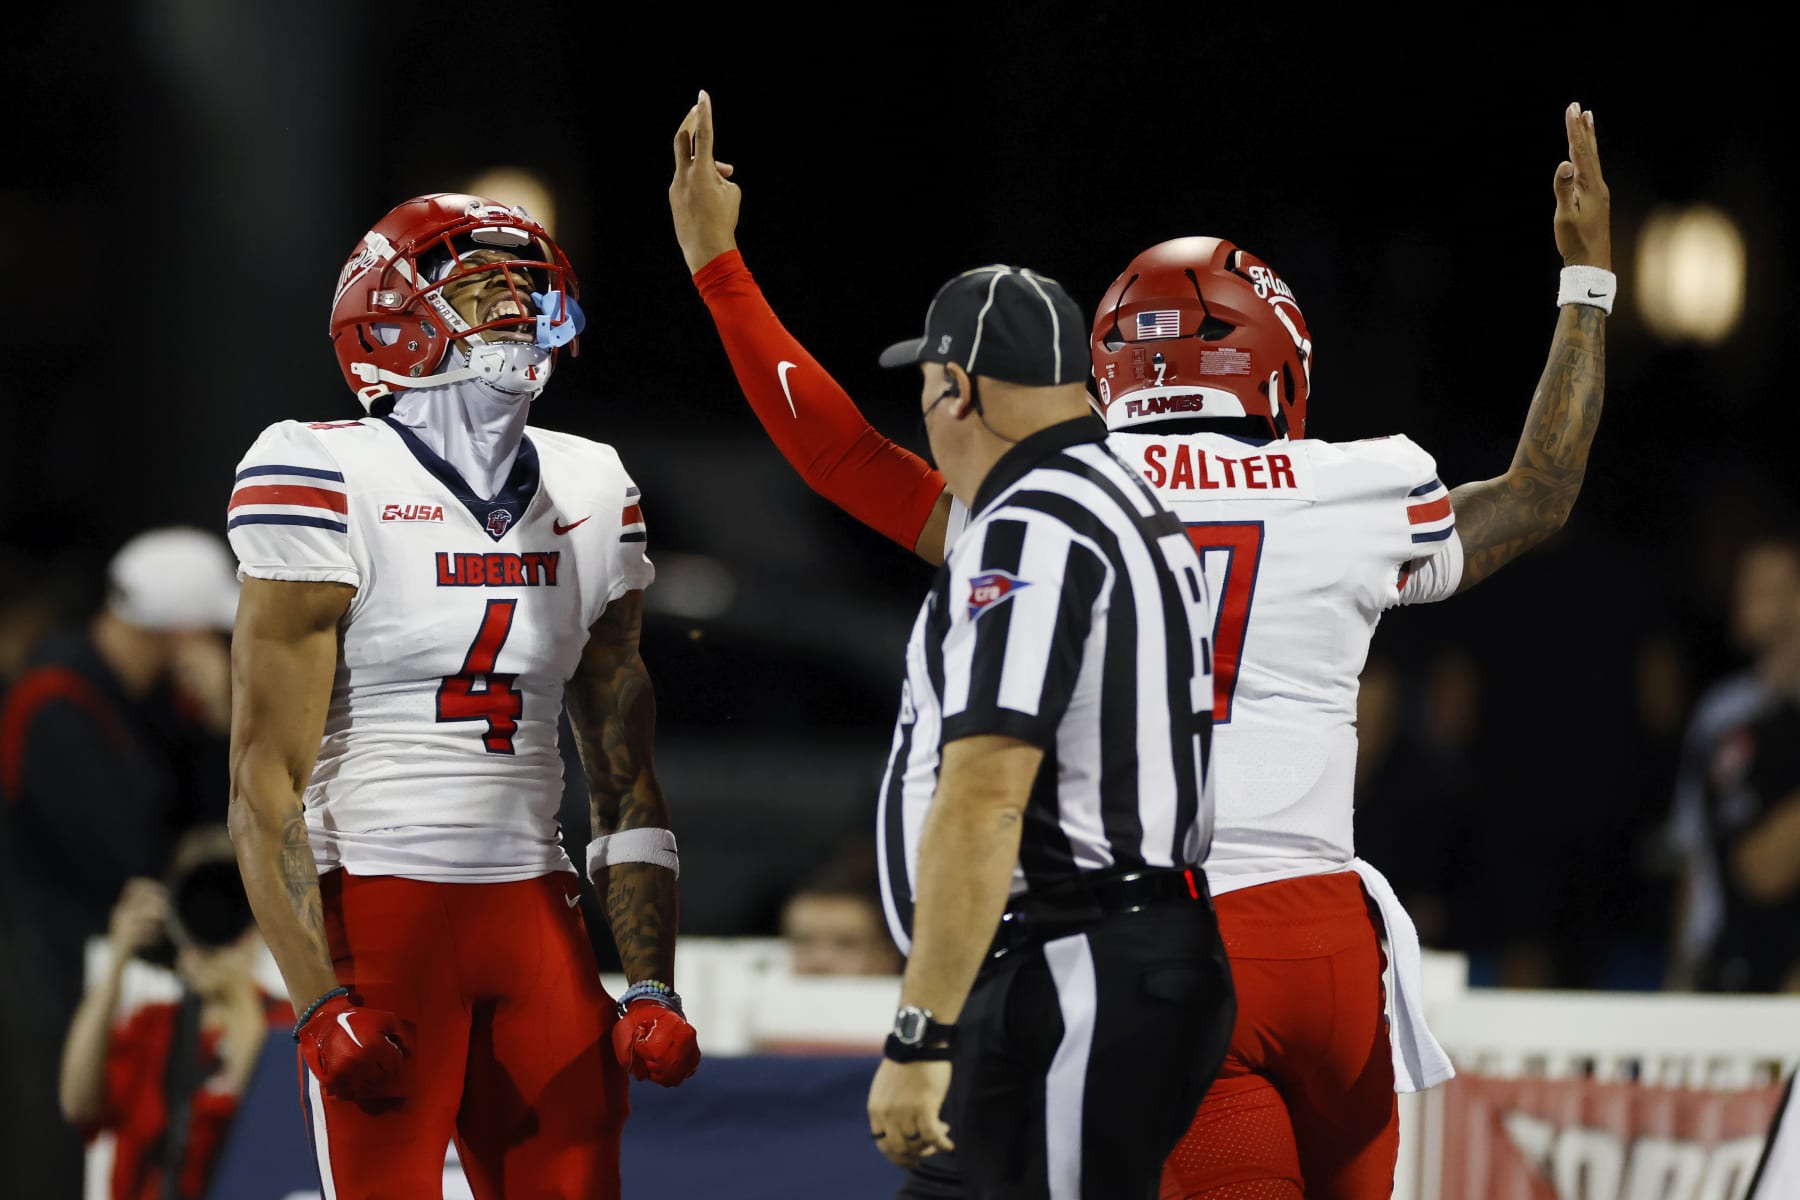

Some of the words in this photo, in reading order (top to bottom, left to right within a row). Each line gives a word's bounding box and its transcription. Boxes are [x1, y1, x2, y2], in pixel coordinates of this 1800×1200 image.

[1153, 362, 1167, 387] 7
[1125, 393, 1204, 418] FLAMES
[1143, 444, 1298, 490] SALTER
[435, 551, 560, 587] LIBERTY
[1184, 520, 1265, 725] 7
[435, 598, 523, 755] 4
